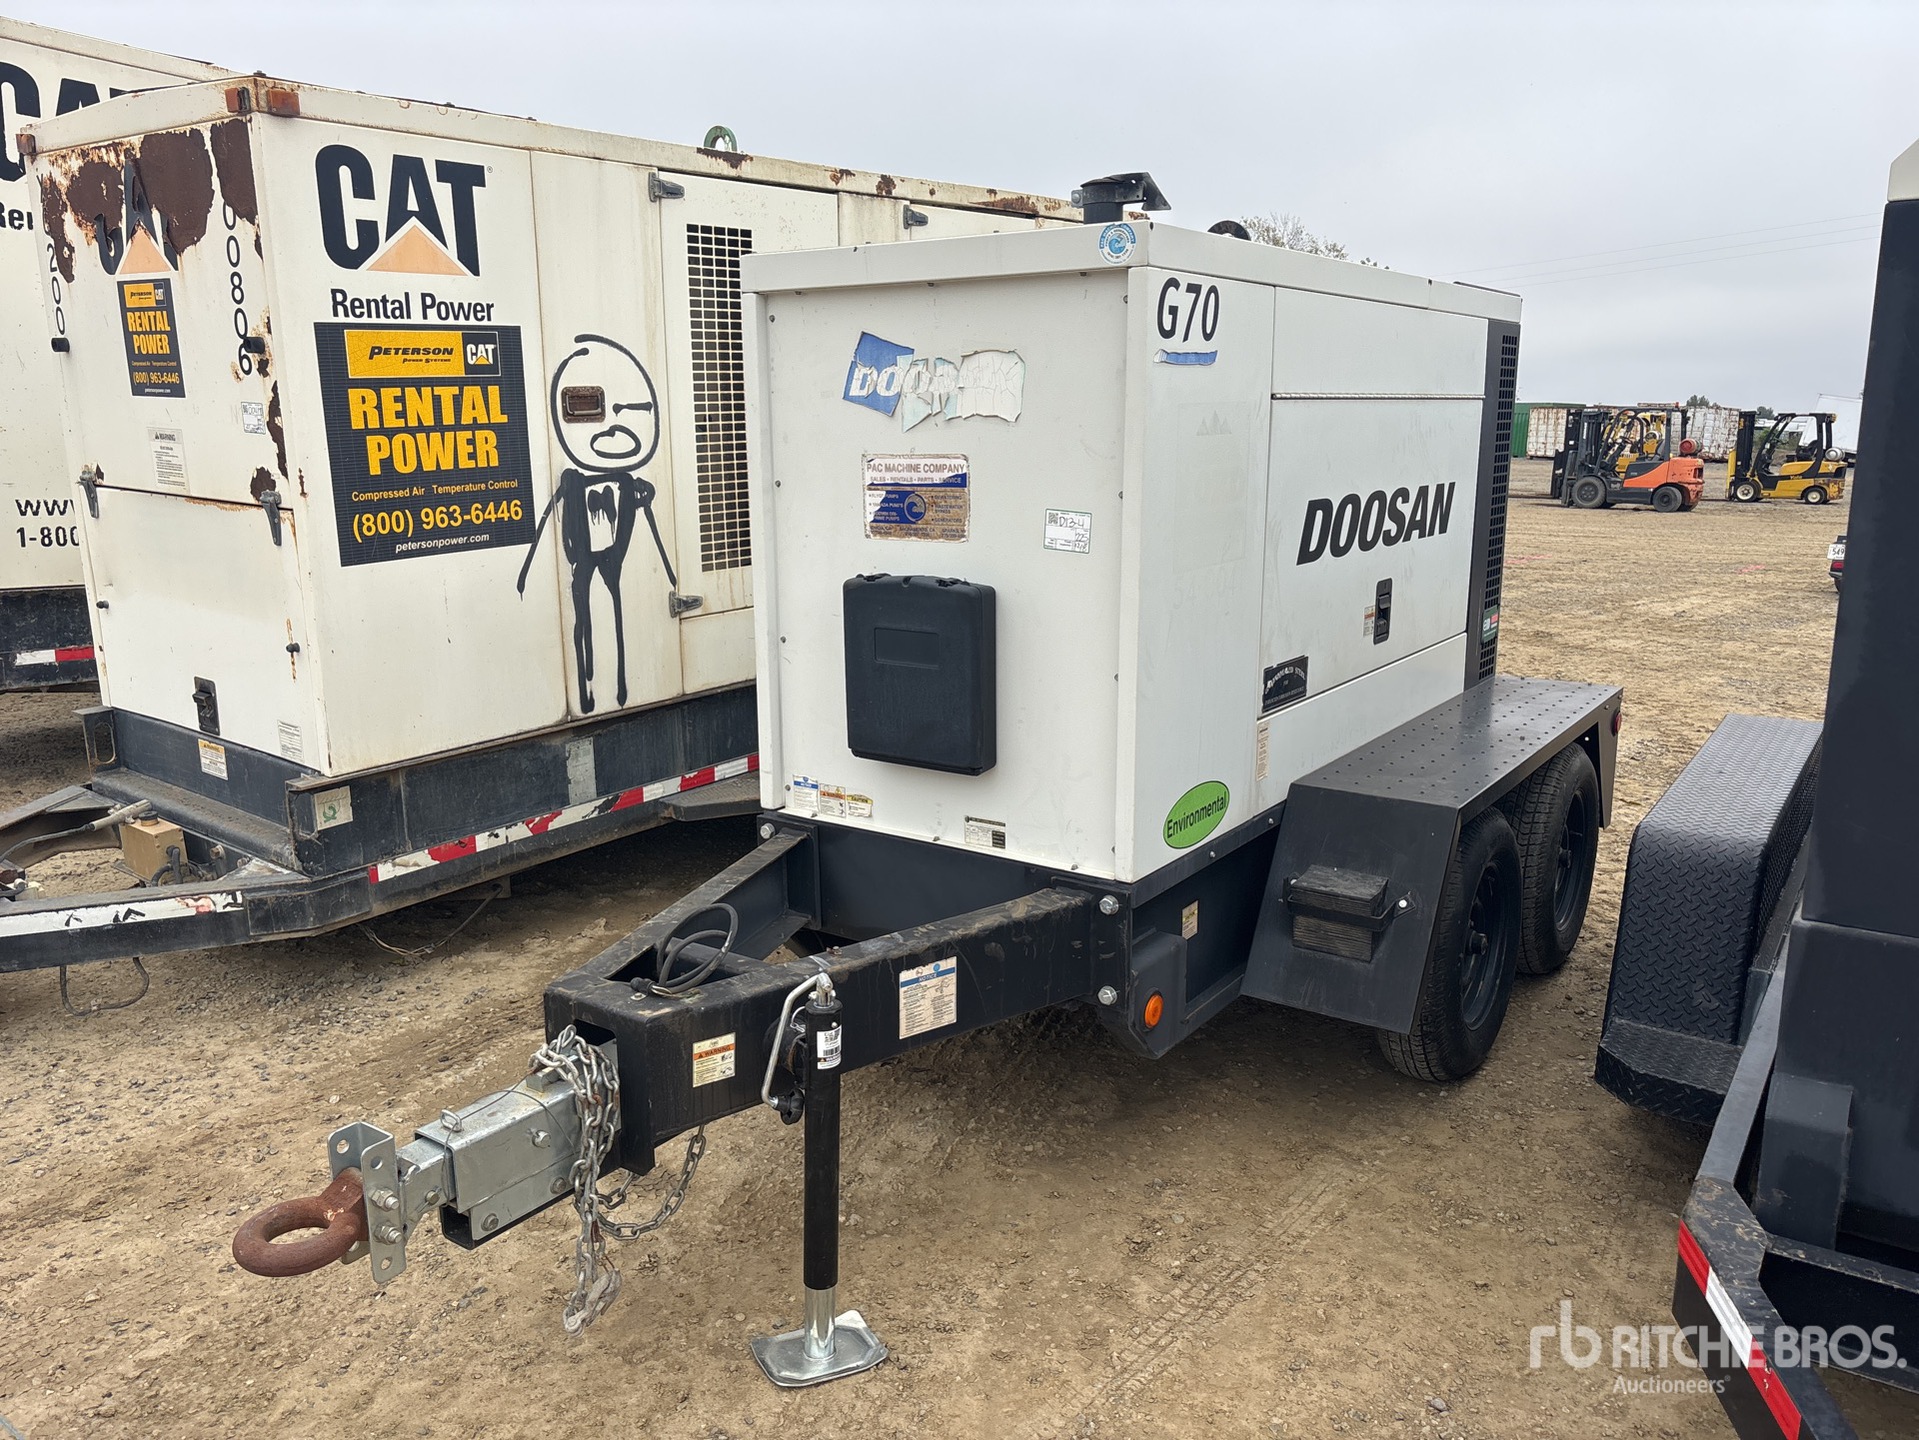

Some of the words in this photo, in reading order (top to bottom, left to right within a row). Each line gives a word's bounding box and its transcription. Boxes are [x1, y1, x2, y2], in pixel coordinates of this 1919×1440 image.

[315, 144, 486, 277] CAT
[330, 288, 412, 320] Rental
[420, 292, 495, 322] Power
[1157, 277, 1219, 343] G70
[126, 310, 171, 332] RENTAL
[132, 334, 171, 355] POWER
[369, 345, 454, 360] PETERSON
[466, 343, 496, 365] CAT
[150, 372, 180, 384] 963-6446
[348, 385, 509, 430] RENTAL
[366, 430, 499, 476] POWER
[867, 463, 883, 473] PAC
[884, 463, 921, 473] MACHINE
[922, 463, 965, 473] COMPANY
[352, 488, 410, 501] Compressed
[412, 486, 426, 496] Air
[432, 481, 486, 495] Temperature
[487, 479, 518, 490] Control
[353, 509, 414, 543] (800)
[420, 499, 523, 530] 963-6446
[1296, 481, 1456, 566] DOOSAN
[395, 533, 490, 554] petersonpower.com
[1167, 790, 1227, 839] Environmental
[705, 1045, 731, 1057] WARNING
